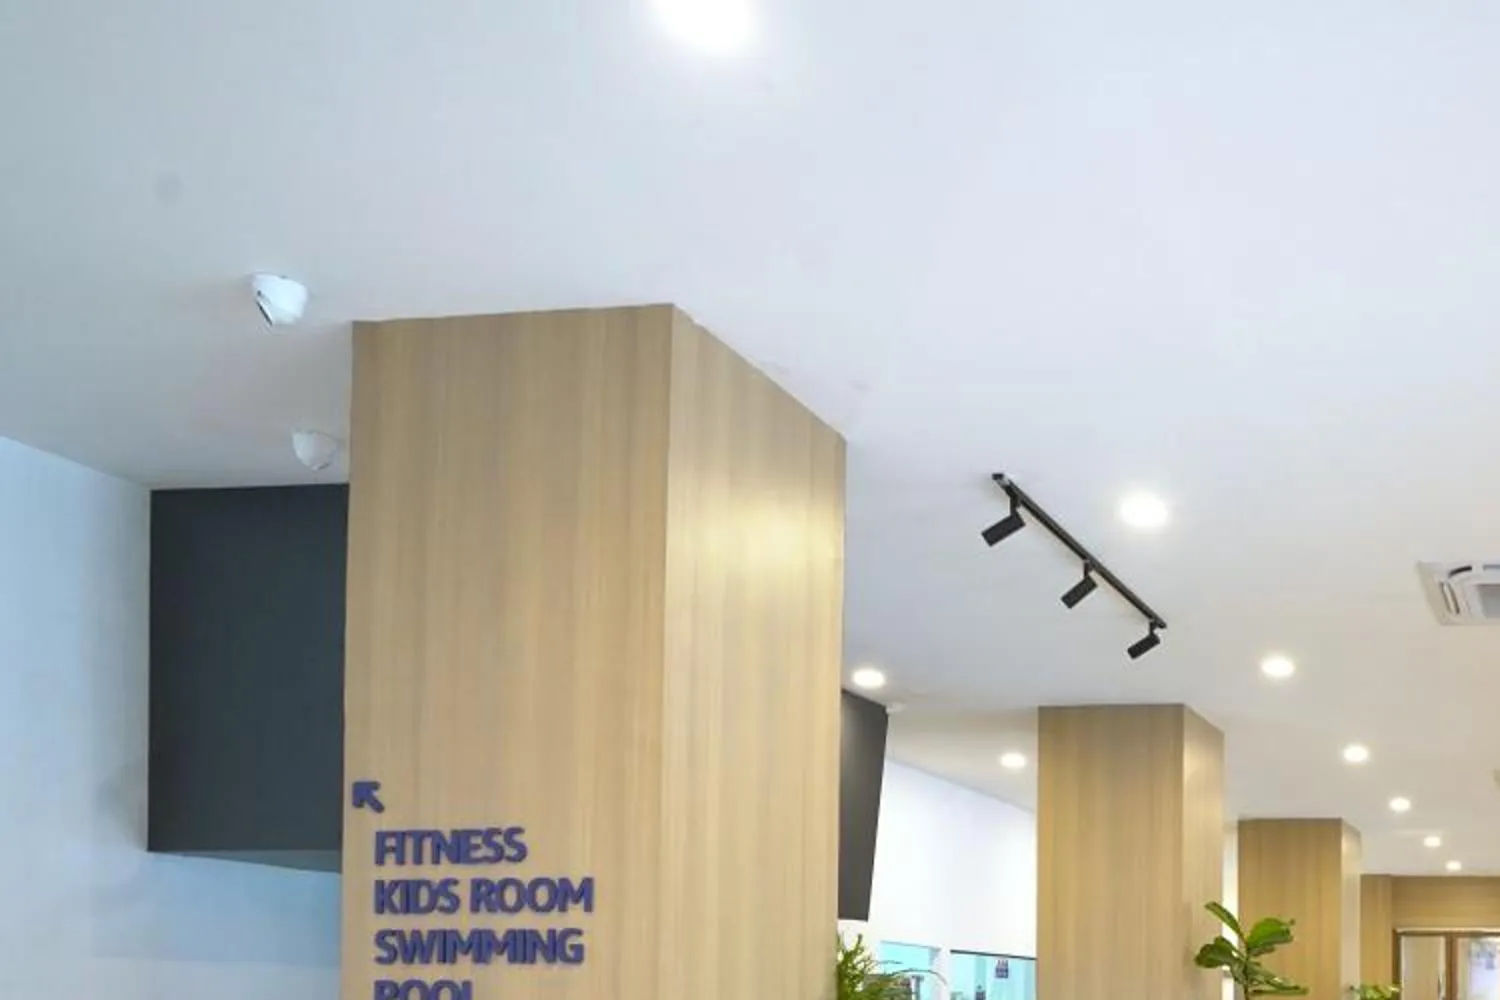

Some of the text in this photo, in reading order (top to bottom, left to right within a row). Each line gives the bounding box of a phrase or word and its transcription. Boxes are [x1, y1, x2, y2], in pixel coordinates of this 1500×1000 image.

[374, 827, 528, 866] FITNESS
[373, 876, 594, 916] KIDS ROOM
[373, 927, 585, 966] SWIMMING
